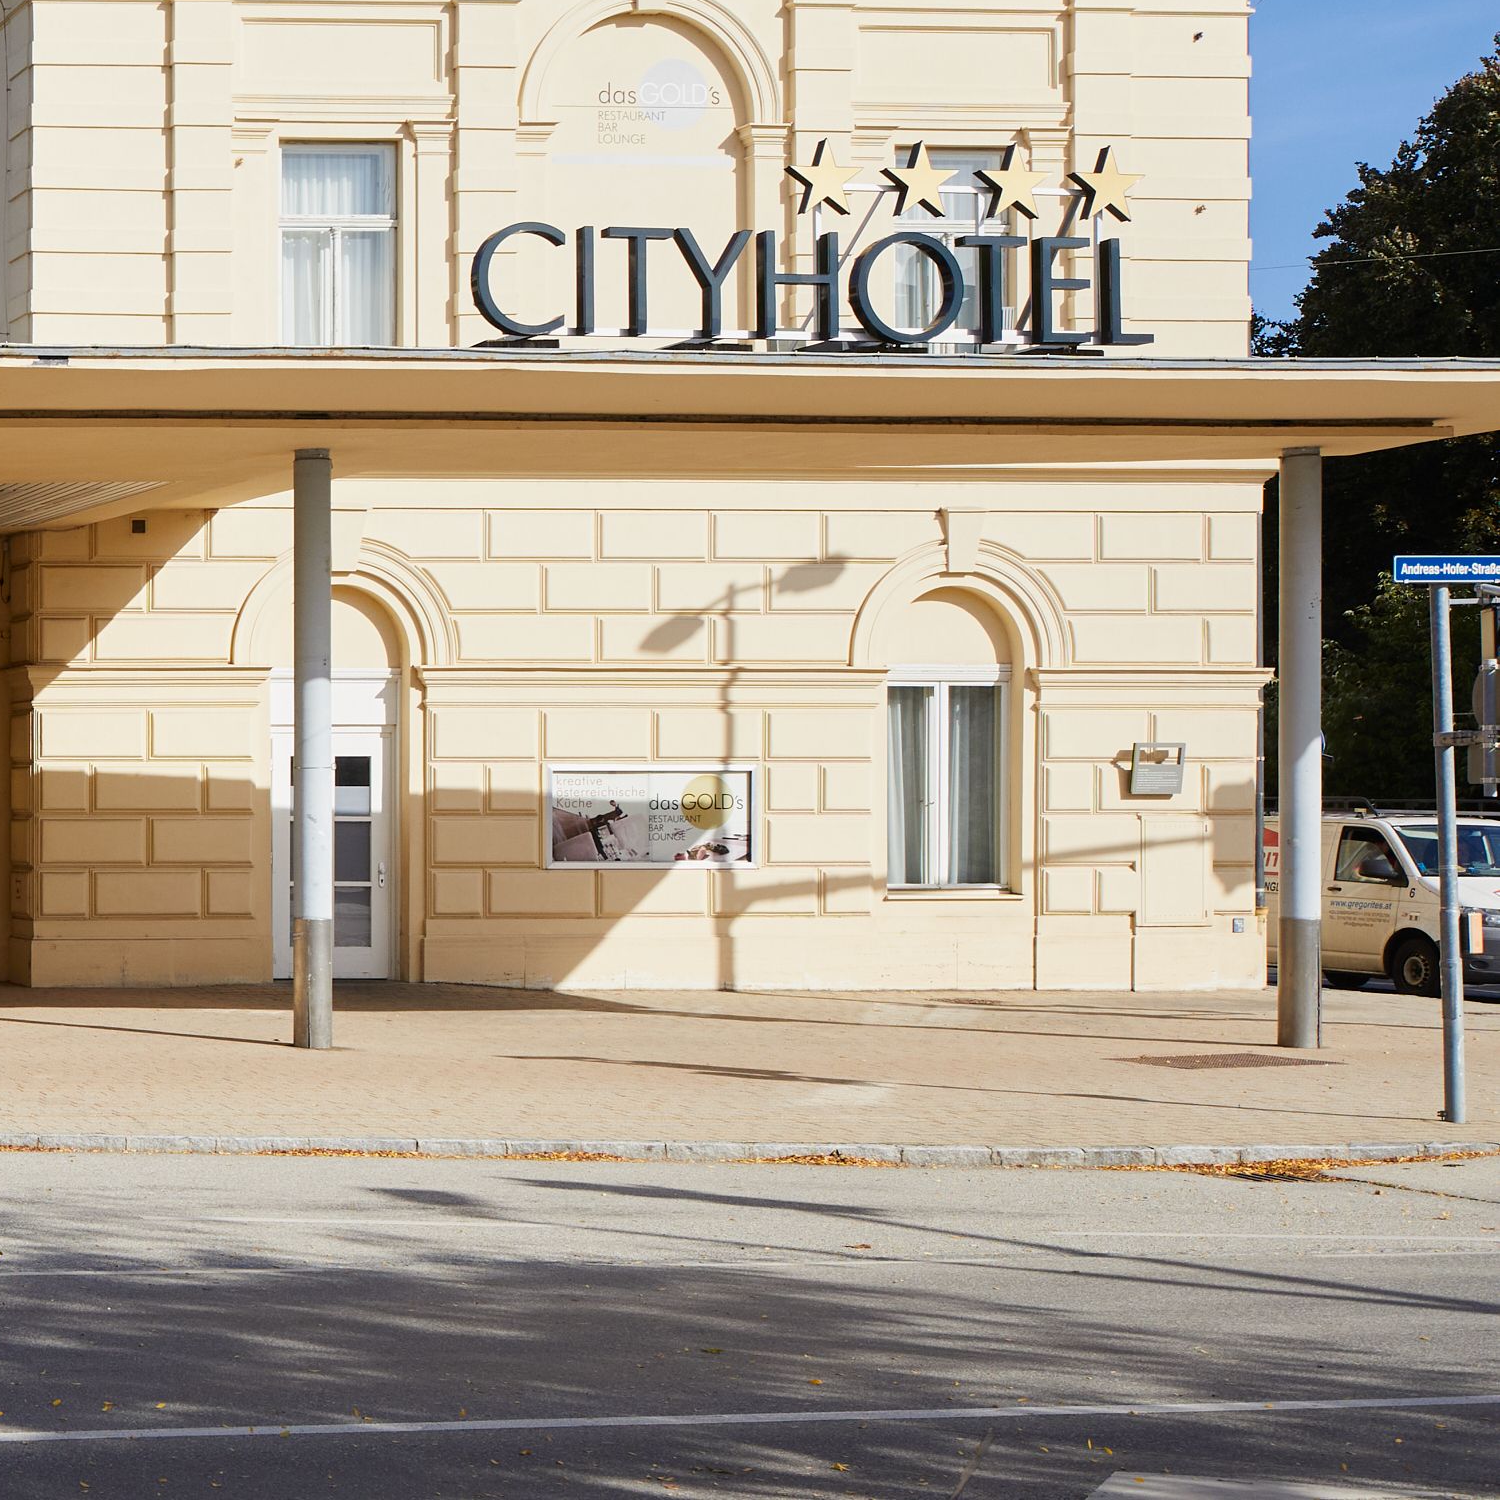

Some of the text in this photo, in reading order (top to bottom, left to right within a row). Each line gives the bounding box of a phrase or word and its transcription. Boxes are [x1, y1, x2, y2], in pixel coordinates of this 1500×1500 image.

[597, 110, 666, 121] RESTAURANT
[597, 122, 618, 132] BAR
[597, 134, 646, 145] LOUNGE
[469, 221, 1155, 345] CITYHOTEL
[1401, 562, 1500, 575] Andreas-Hofer-Straße
[556, 774, 603, 786] kreative
[556, 786, 646, 797] österreichische
[556, 797, 593, 808] Küche
[648, 814, 702, 823] RESTAURANT
[648, 823, 664, 832] BAR
[648, 832, 686, 841] LOUNGE
[1409, 887, 1416, 898] 6
